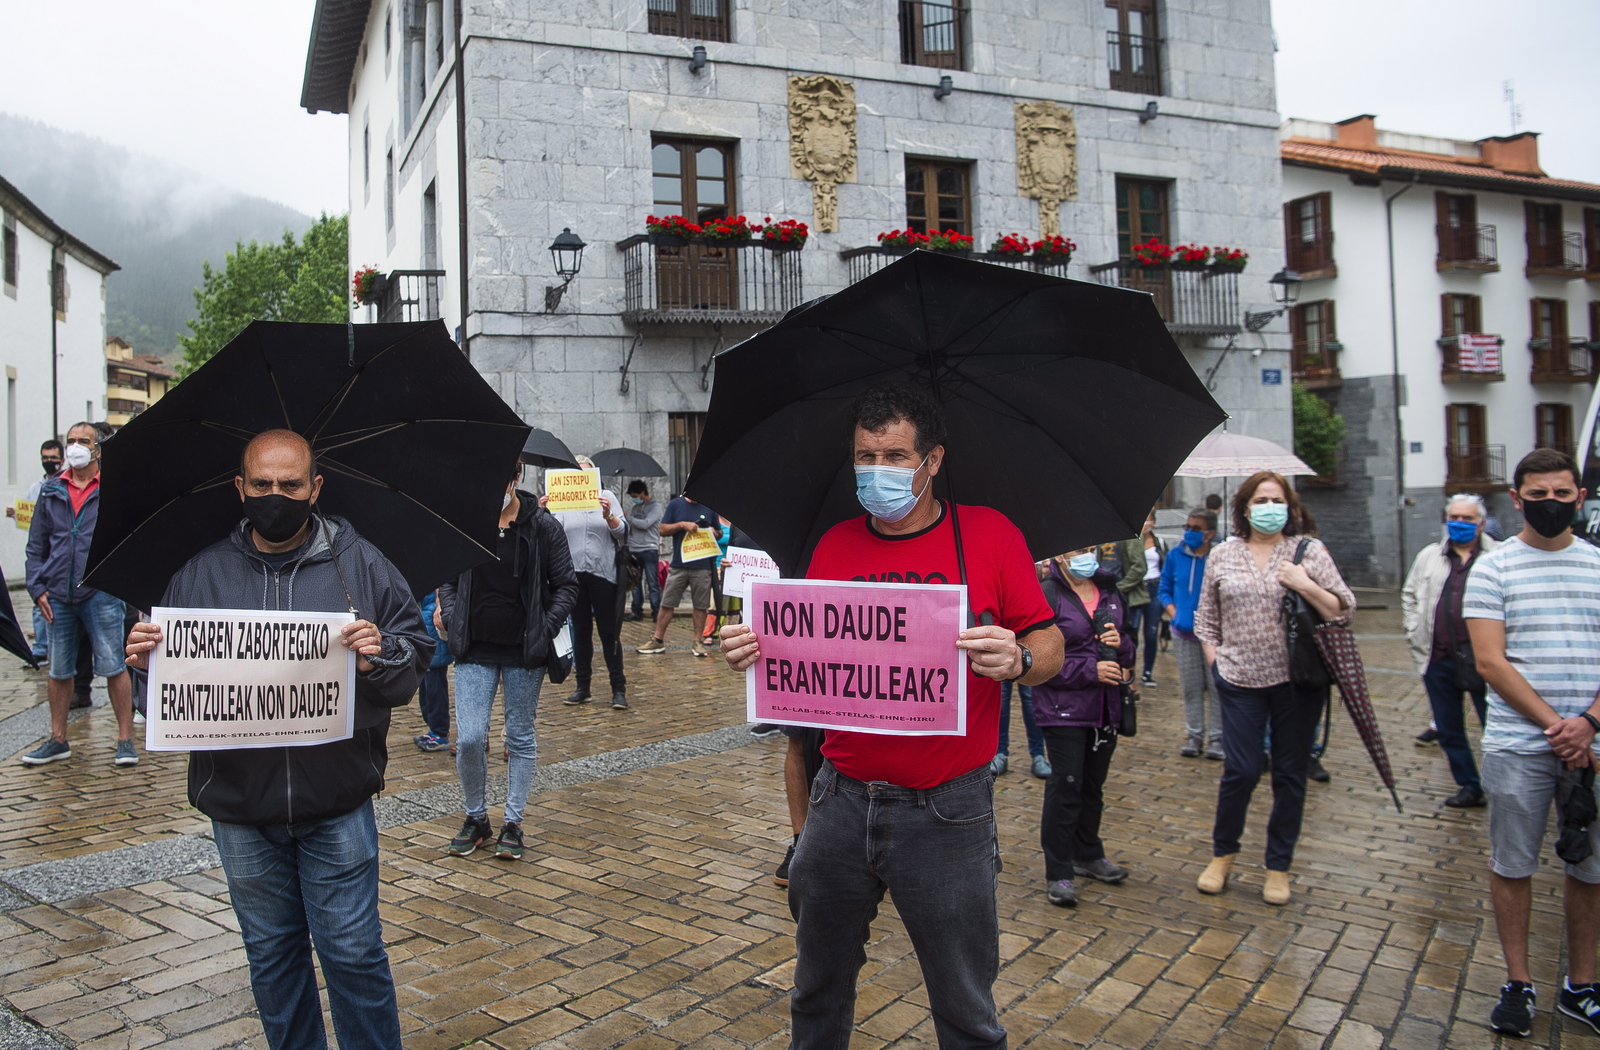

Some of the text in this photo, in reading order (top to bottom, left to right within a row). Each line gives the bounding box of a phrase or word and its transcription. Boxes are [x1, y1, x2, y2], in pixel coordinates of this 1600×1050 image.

[551, 475, 589, 486] LAN ISTRIPU
[730, 553, 758, 568] JOAQUIN
[166, 619, 329, 661] LOTSAREN ZABORTEGIKO
[763, 600, 907, 643] NON DAUDE
[161, 680, 340, 722] ERANTZULEAK NON DAUDE?
[765, 657, 949, 703] ERANTZULEAK?
